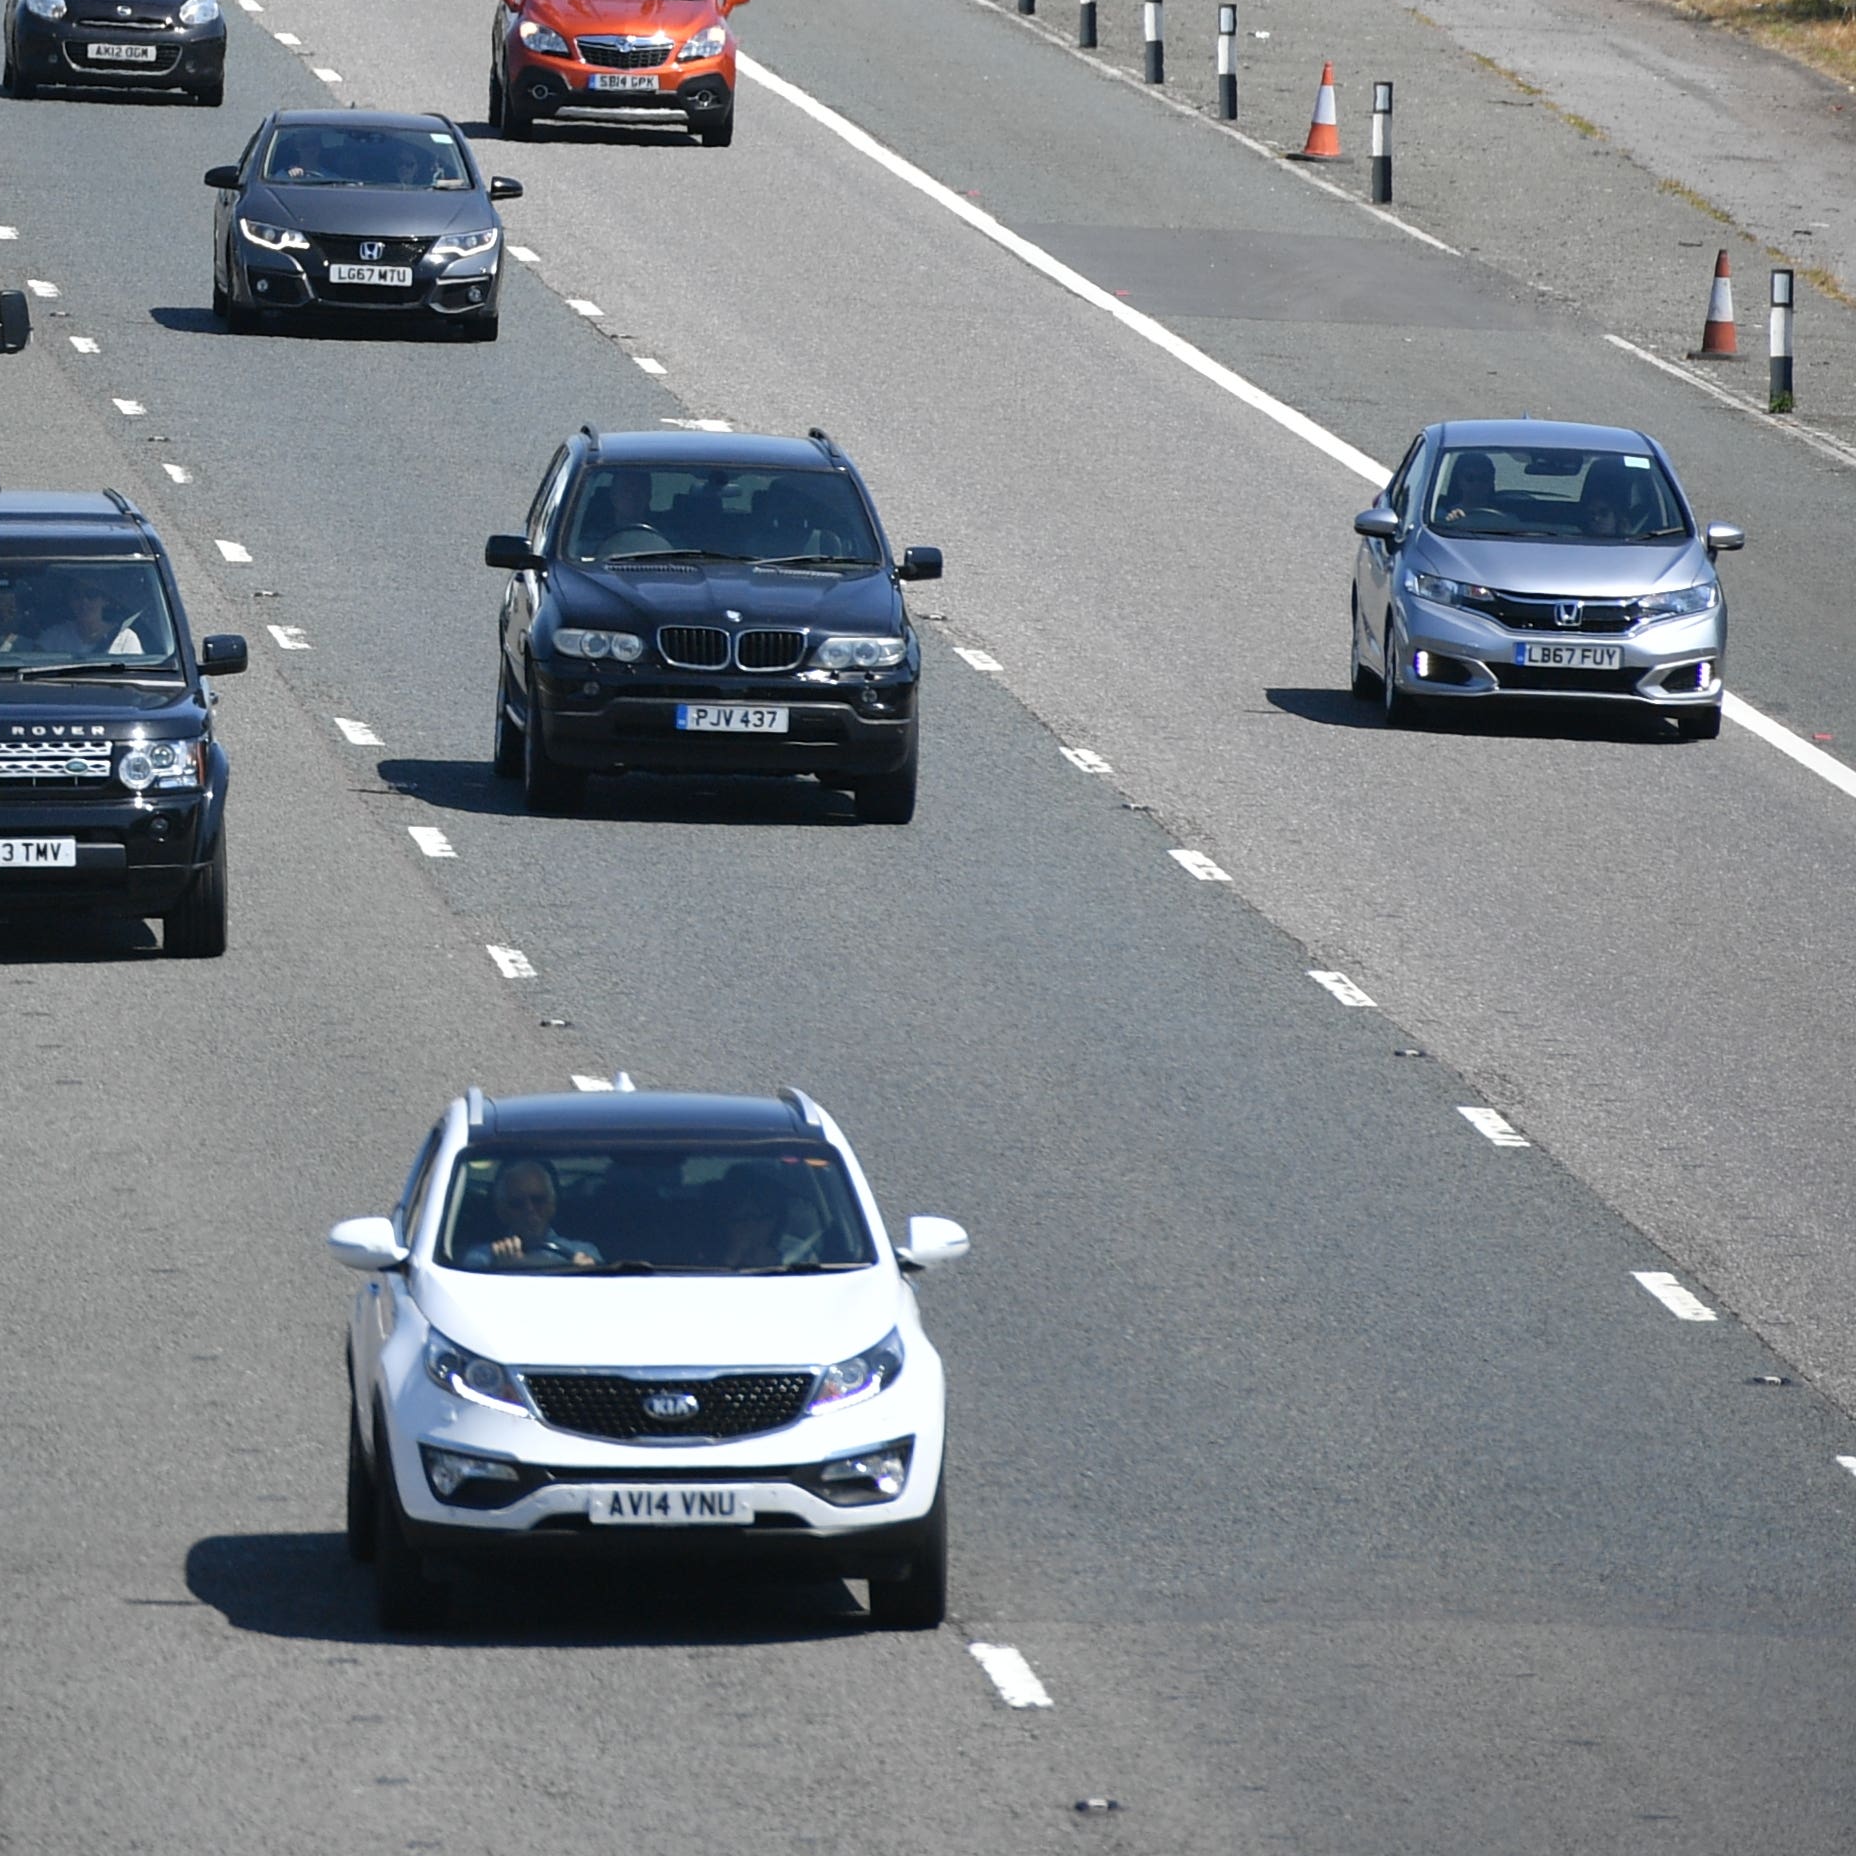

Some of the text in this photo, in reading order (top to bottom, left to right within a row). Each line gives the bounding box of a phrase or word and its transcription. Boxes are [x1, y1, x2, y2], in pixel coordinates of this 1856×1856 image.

[338, 267, 406, 283] LG67 MTU
[1528, 646, 1618, 666] LB67 FUY
[696, 710, 778, 728] PJV 437
[11, 725, 105, 736] ROVER
[24, 842, 62, 861] TMV
[652, 1398, 689, 1416] KIA
[608, 1491, 735, 1516] AV14 VNU
